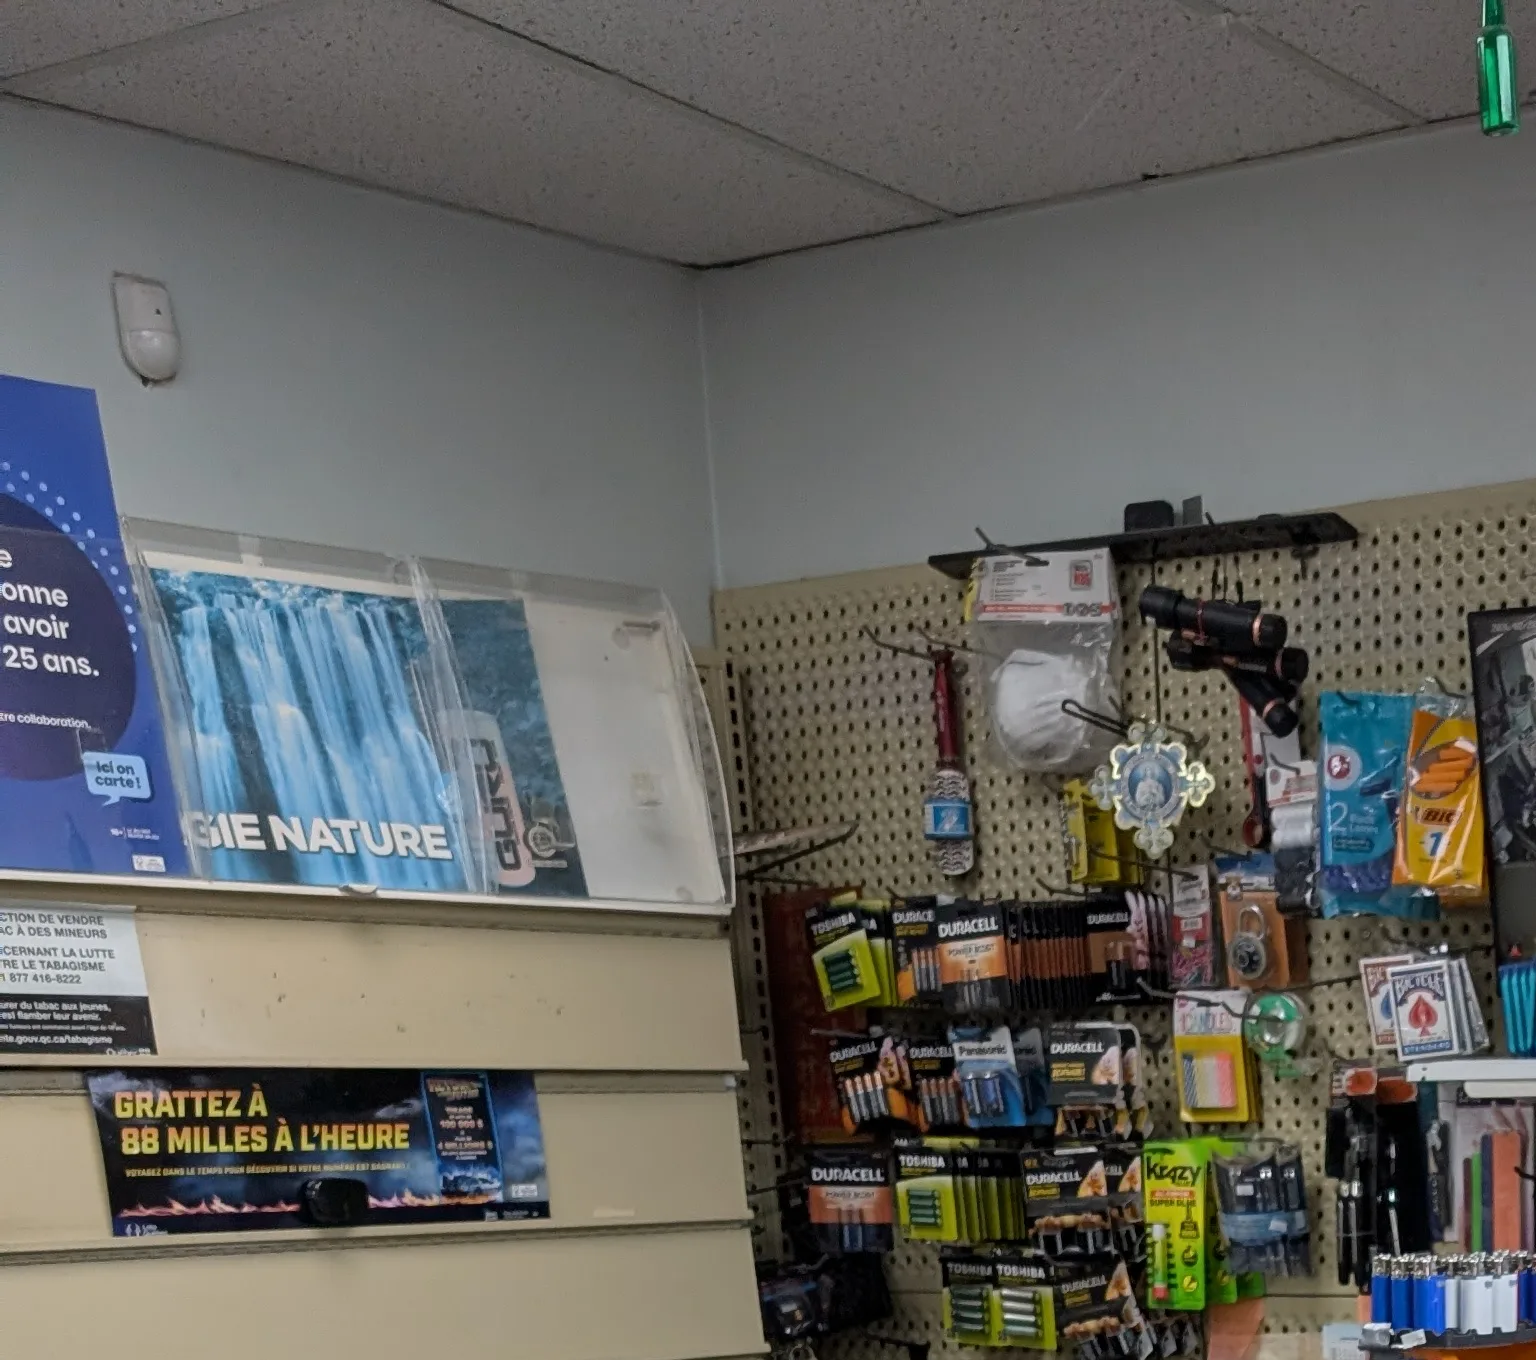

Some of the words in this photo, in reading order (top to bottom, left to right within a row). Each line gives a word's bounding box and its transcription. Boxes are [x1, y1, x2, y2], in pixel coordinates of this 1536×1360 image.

[4, 614, 69, 639] avoir
[3, 645, 38, 670] 25
[43, 652, 100, 677] ans.
[17, 715, 92, 729] collaboration.
[96, 761, 114, 774] Ici
[117, 764, 135, 775] on
[268, 815, 453, 861] NATURE
[38, 913, 55, 924] DE
[57, 914, 104, 926] VENDRE
[937, 914, 999, 938] DURACELL
[28, 926, 52, 937] DES
[54, 928, 107, 939] MINEURS
[61, 948, 77, 958] LA
[79, 949, 115, 959] LUTTE
[22, 960, 37, 970] LE
[40, 960, 106, 972] TABAGISME
[9, 973, 29, 983] 877
[1050, 1041, 1105, 1056] DURACELL
[113, 1090, 240, 1118] GRATTEZ
[248, 1082, 268, 1118] À
[121, 1126, 160, 1155] 88
[167, 1125, 268, 1154] MILLES
[276, 1116, 295, 1152] À
[299, 1123, 411, 1152] L'HEURE
[899, 1154, 945, 1169] TOSHIBA
[810, 1165, 885, 1183] DURACELL
[1025, 1171, 1083, 1186] DURACELL
[948, 1261, 993, 1277] TOSHIBA
[996, 1262, 1045, 1279] TOSHIBA
